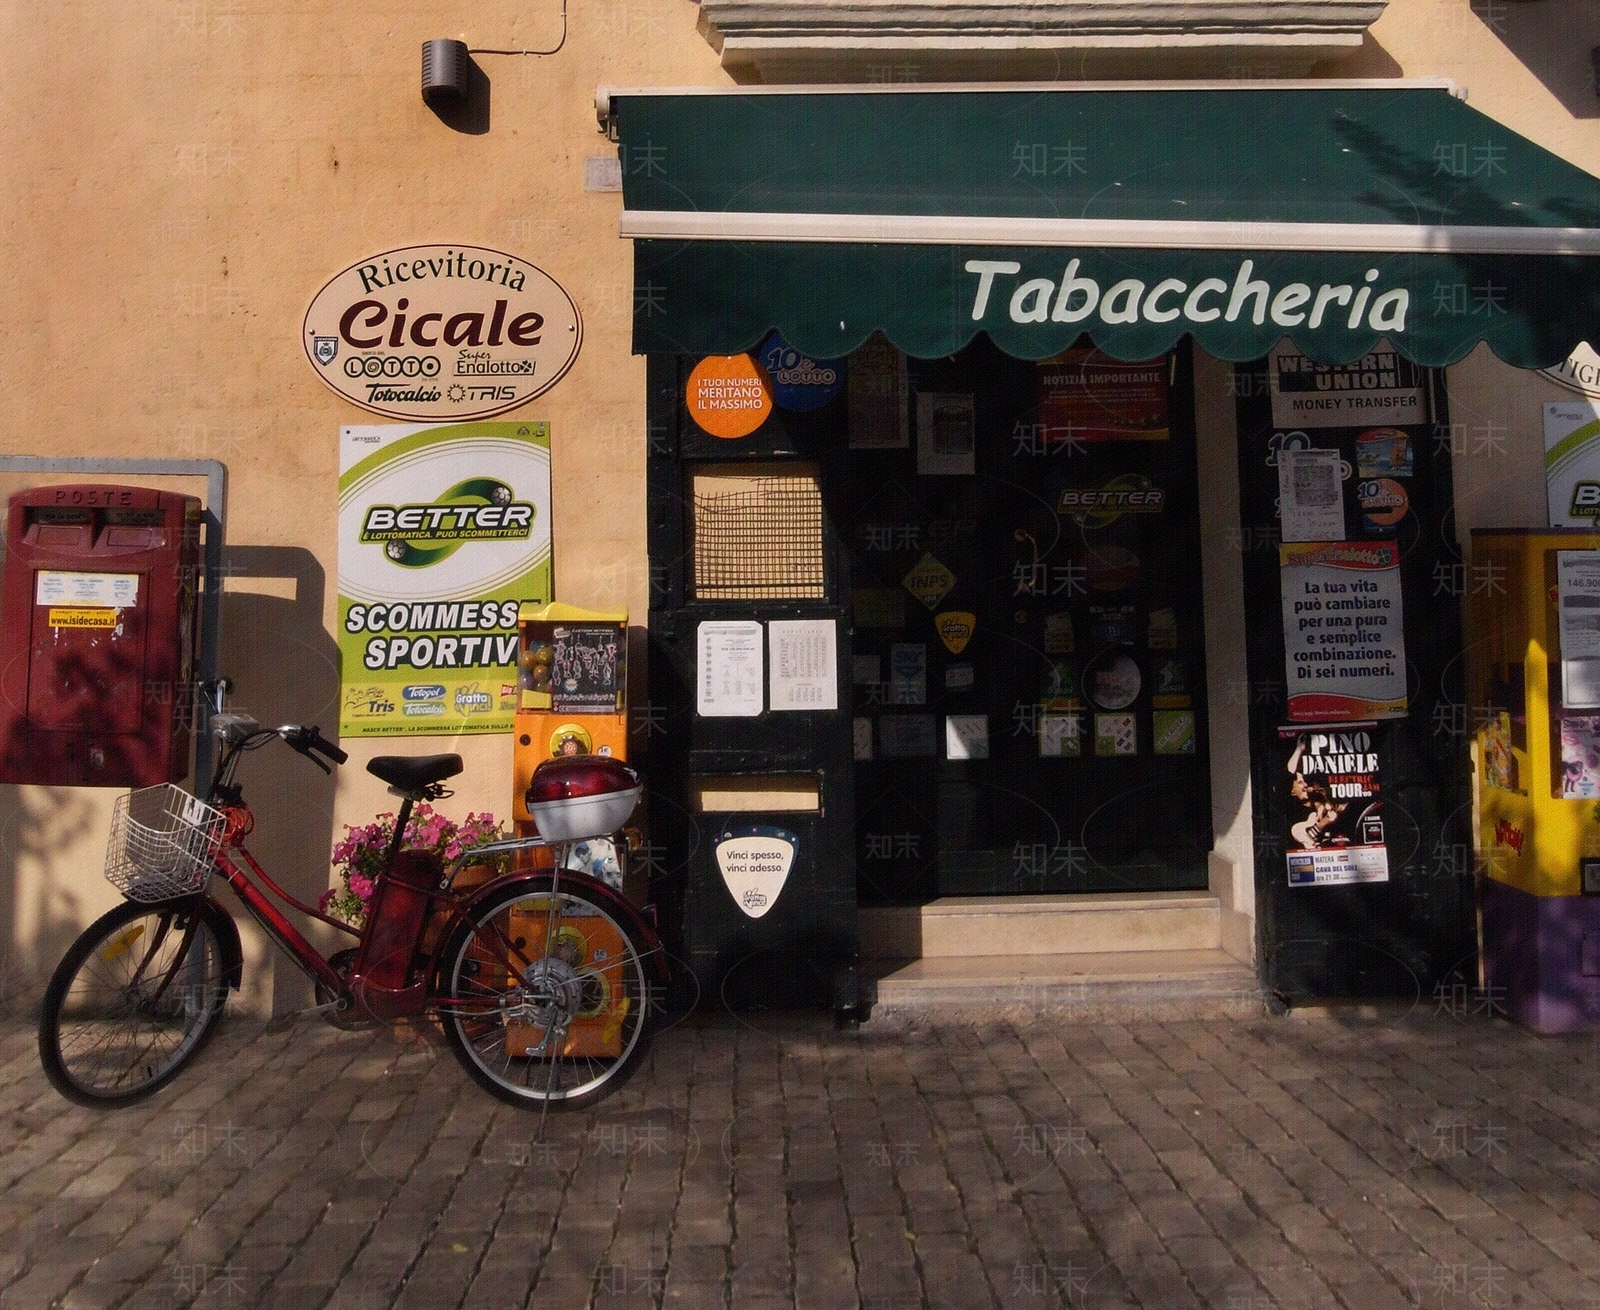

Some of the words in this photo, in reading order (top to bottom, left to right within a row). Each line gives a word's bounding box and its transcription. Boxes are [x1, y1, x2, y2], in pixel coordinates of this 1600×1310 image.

[357, 250, 526, 294] Ricevitoria
[964, 258, 1409, 332] Tabaccheria
[339, 297, 545, 349] Cicale
[458, 349, 491, 362] Super
[1278, 353, 1395, 373] WESERN
[344, 355, 441, 378] LOTTO
[457, 360, 520, 374] Enalotto
[1559, 358, 1600, 387] TIG
[702, 378, 726, 387] TUOI
[727, 378, 762, 387] NUMERI
[1043, 374, 1087, 385] NOTIZIA
[1090, 372, 1160, 384] IMPORTANTE
[1316, 371, 1396, 390] UNION
[366, 383, 442, 403] Totocalcio
[467, 386, 517, 400] TRIS
[698, 387, 762, 398] MERITANO
[698, 400, 707, 409] IL
[710, 399, 763, 409] MASSIMO
[1293, 398, 1342, 410] MONEY
[1346, 396, 1417, 408] TRANSFER
[1357, 480, 1380, 499] 10
[1575, 485, 1600, 505] B
[55, 490, 133, 506] POSTE
[1062, 491, 1162, 505] BETTER
[367, 507, 531, 530] BETTER
[460, 529, 528, 538] SCOMMETTERCI
[910, 574, 949, 588] INPS
[1305, 582, 1320, 594] La
[1323, 581, 1347, 593] tua
[1350, 579, 1378, 593] vita
[1294, 598, 1322, 614] può
[1325, 596, 1391, 611] cambiare
[51, 614, 115, 626] www.isidecasa.it
[346, 601, 518, 632] SCOMMESS
[1299, 616, 1322, 631] per
[1325, 616, 1352, 627] una
[1355, 614, 1388, 629] pura
[1306, 634, 1315, 645] e
[1319, 630, 1382, 647] semplice
[1293, 646, 1396, 662] combinazione.
[1297, 665, 1312, 679] Di
[1315, 664, 1336, 678] sei
[1339, 662, 1395, 678] numeri.
[408, 686, 447, 699] Totogol
[456, 693, 488, 704] Gratta
[368, 699, 395, 713] Tris
[404, 703, 446, 714] Totocalcio
[1310, 731, 1371, 755] PINO
[1301, 753, 1380, 775] DANIELE
[1329, 783, 1363, 799] TOUR
[726, 851, 748, 860] Vinci
[751, 852, 784, 861] spesso,
[1315, 855, 1334, 864] MATERA
[726, 864, 747, 872] vinci
[750, 863, 784, 872] adesso.
